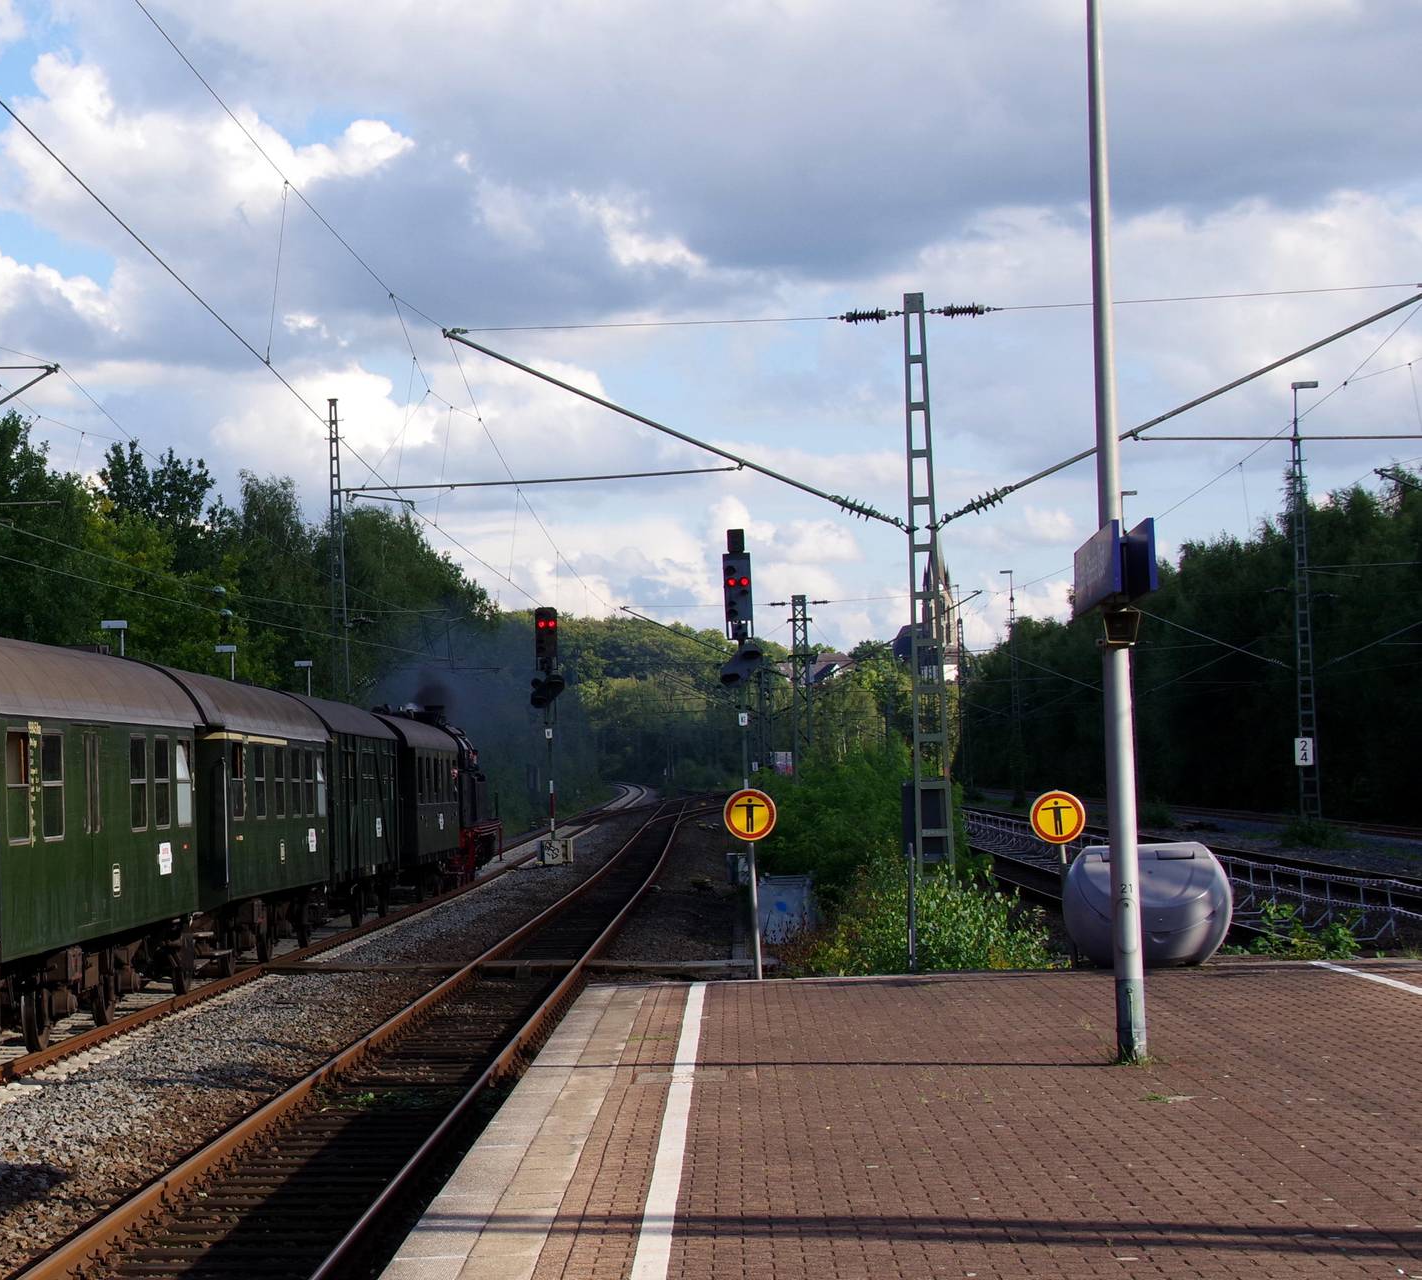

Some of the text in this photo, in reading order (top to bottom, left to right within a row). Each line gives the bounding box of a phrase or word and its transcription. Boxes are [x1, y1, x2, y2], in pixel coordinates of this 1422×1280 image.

[1300, 740, 1308, 752] 2
[1300, 751, 1308, 762] 4
[1120, 883, 1133, 894] 21
